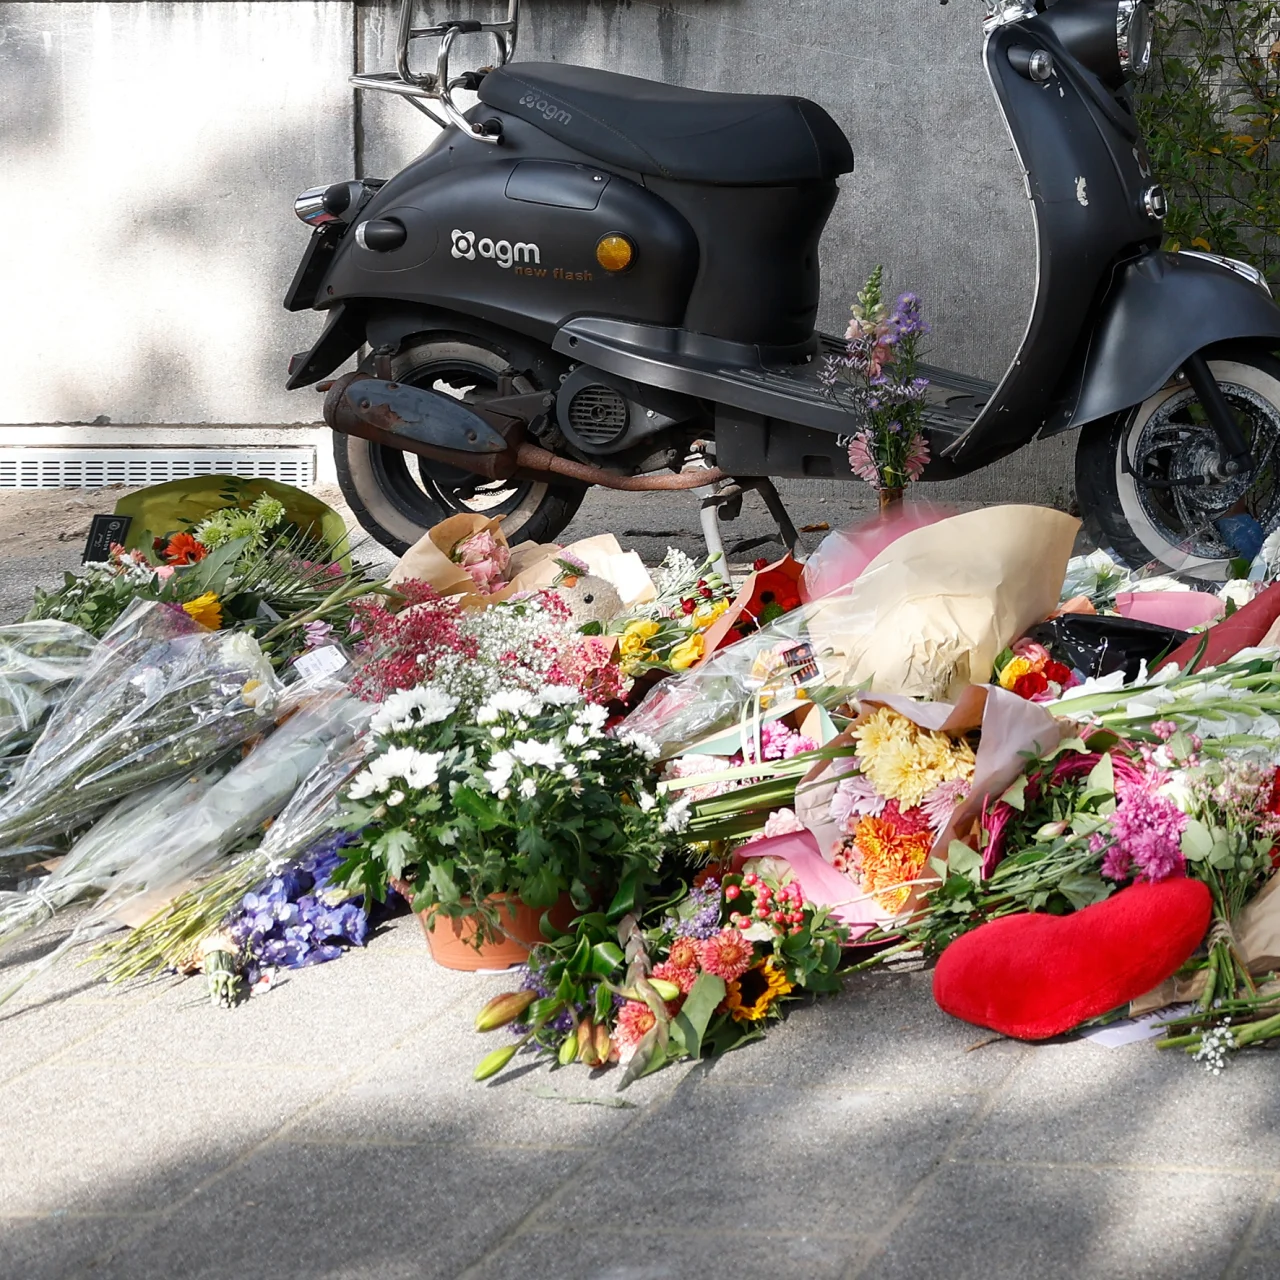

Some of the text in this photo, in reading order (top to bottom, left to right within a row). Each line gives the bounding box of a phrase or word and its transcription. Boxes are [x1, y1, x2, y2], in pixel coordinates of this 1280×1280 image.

[535, 99, 573, 125] agm
[478, 237, 541, 269] agm
[514, 265, 593, 281] new flash
